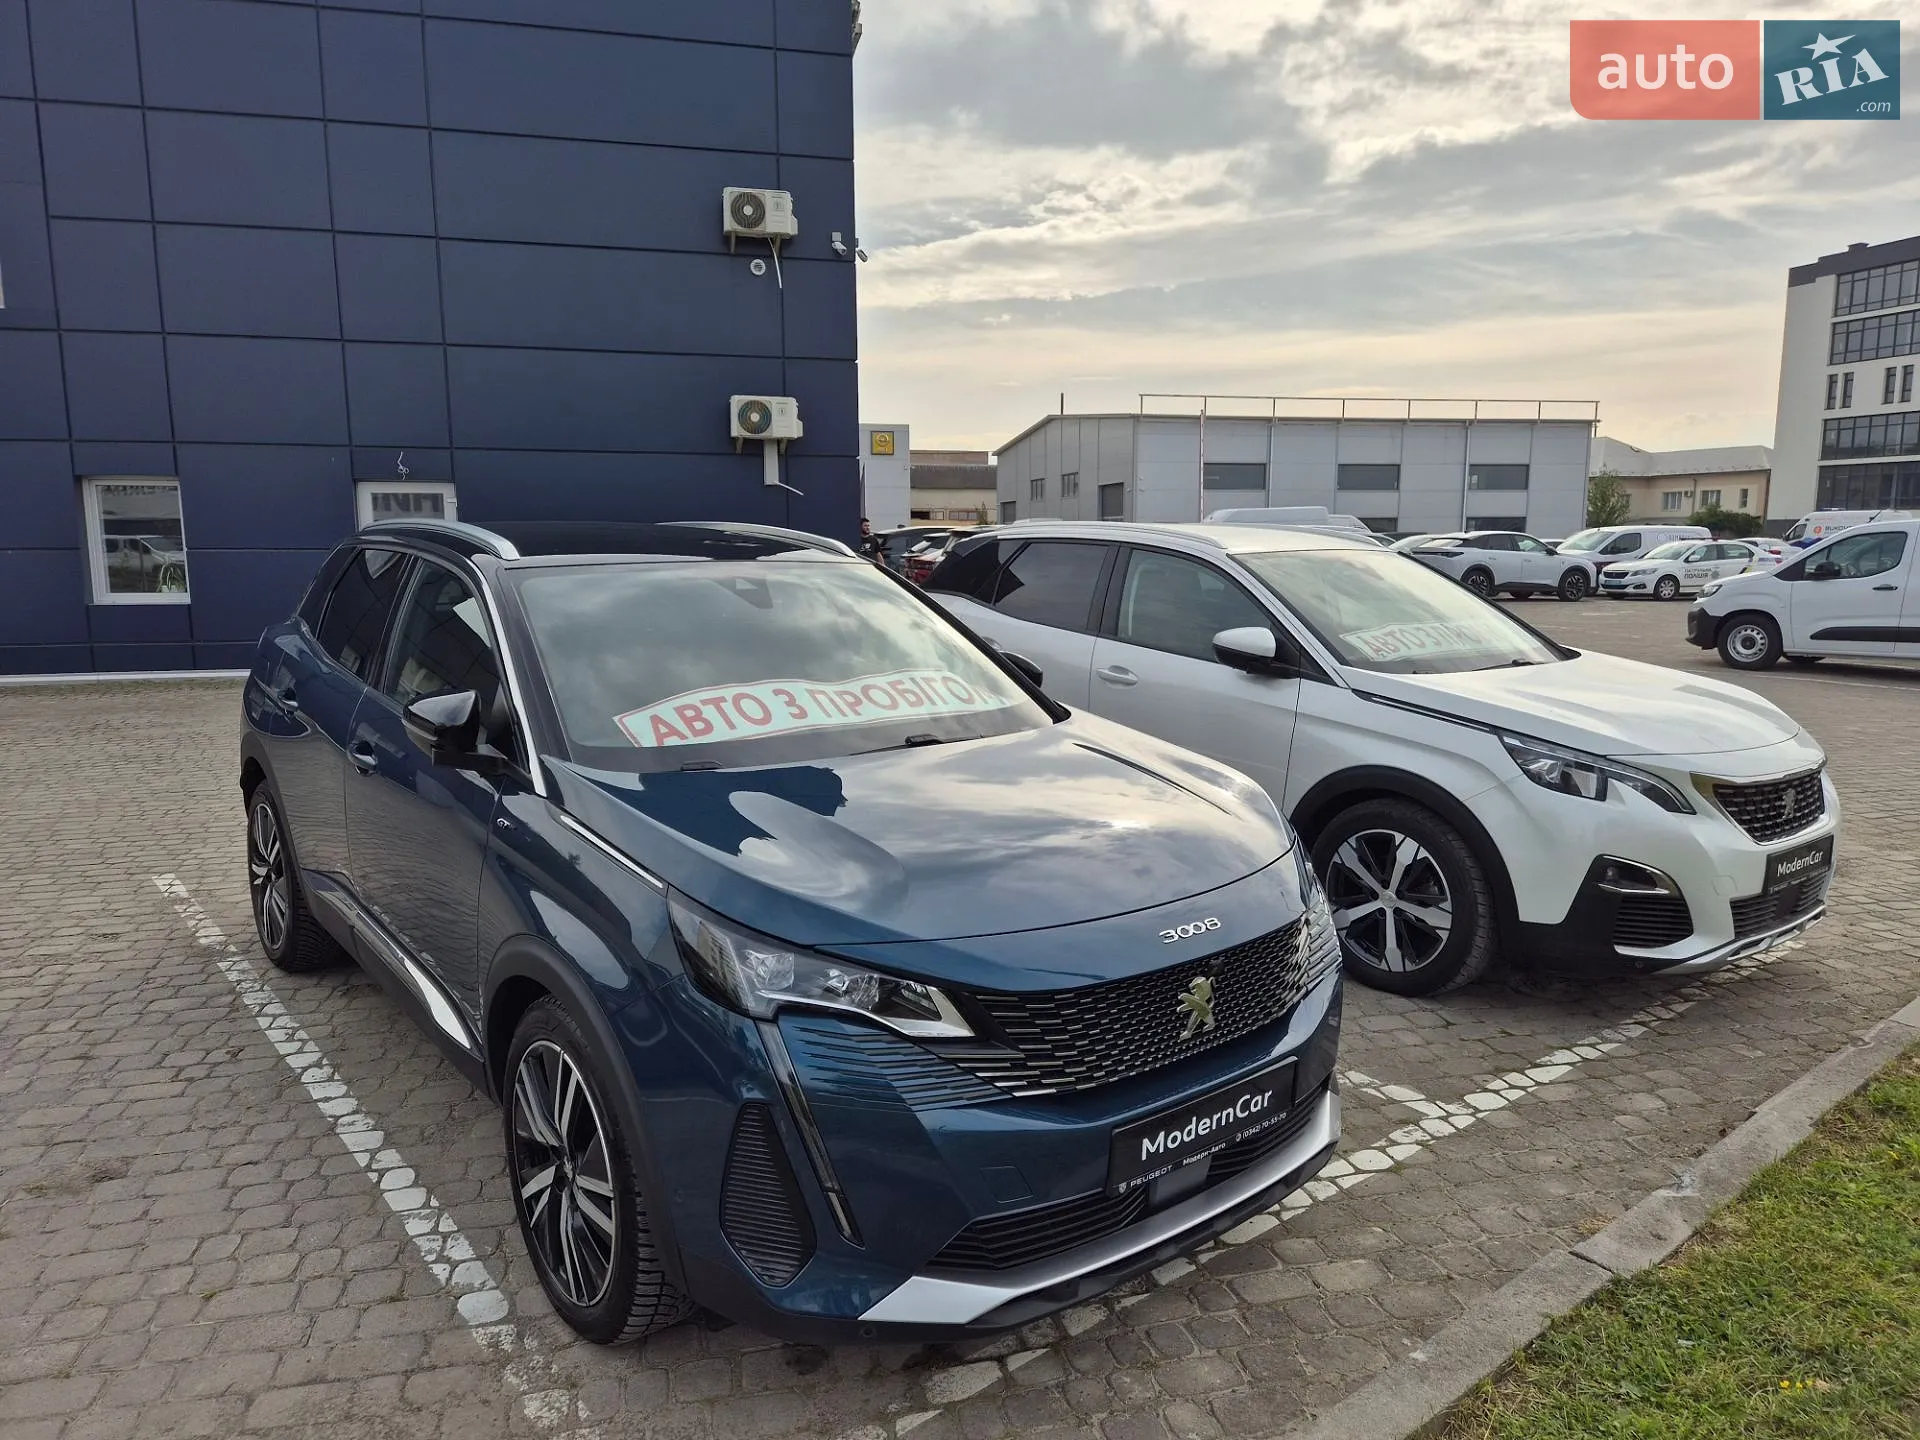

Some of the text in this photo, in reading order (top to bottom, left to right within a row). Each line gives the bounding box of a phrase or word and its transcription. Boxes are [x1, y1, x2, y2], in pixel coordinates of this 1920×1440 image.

[648, 692, 772, 746] АВТО
[772, 688, 808, 720] З
[1777, 850, 1824, 877] ModernCar
[1159, 917, 1221, 944] 3008
[1141, 1089, 1273, 1161] ModernCar
[1130, 1164, 1173, 1187] PEUGEOT
